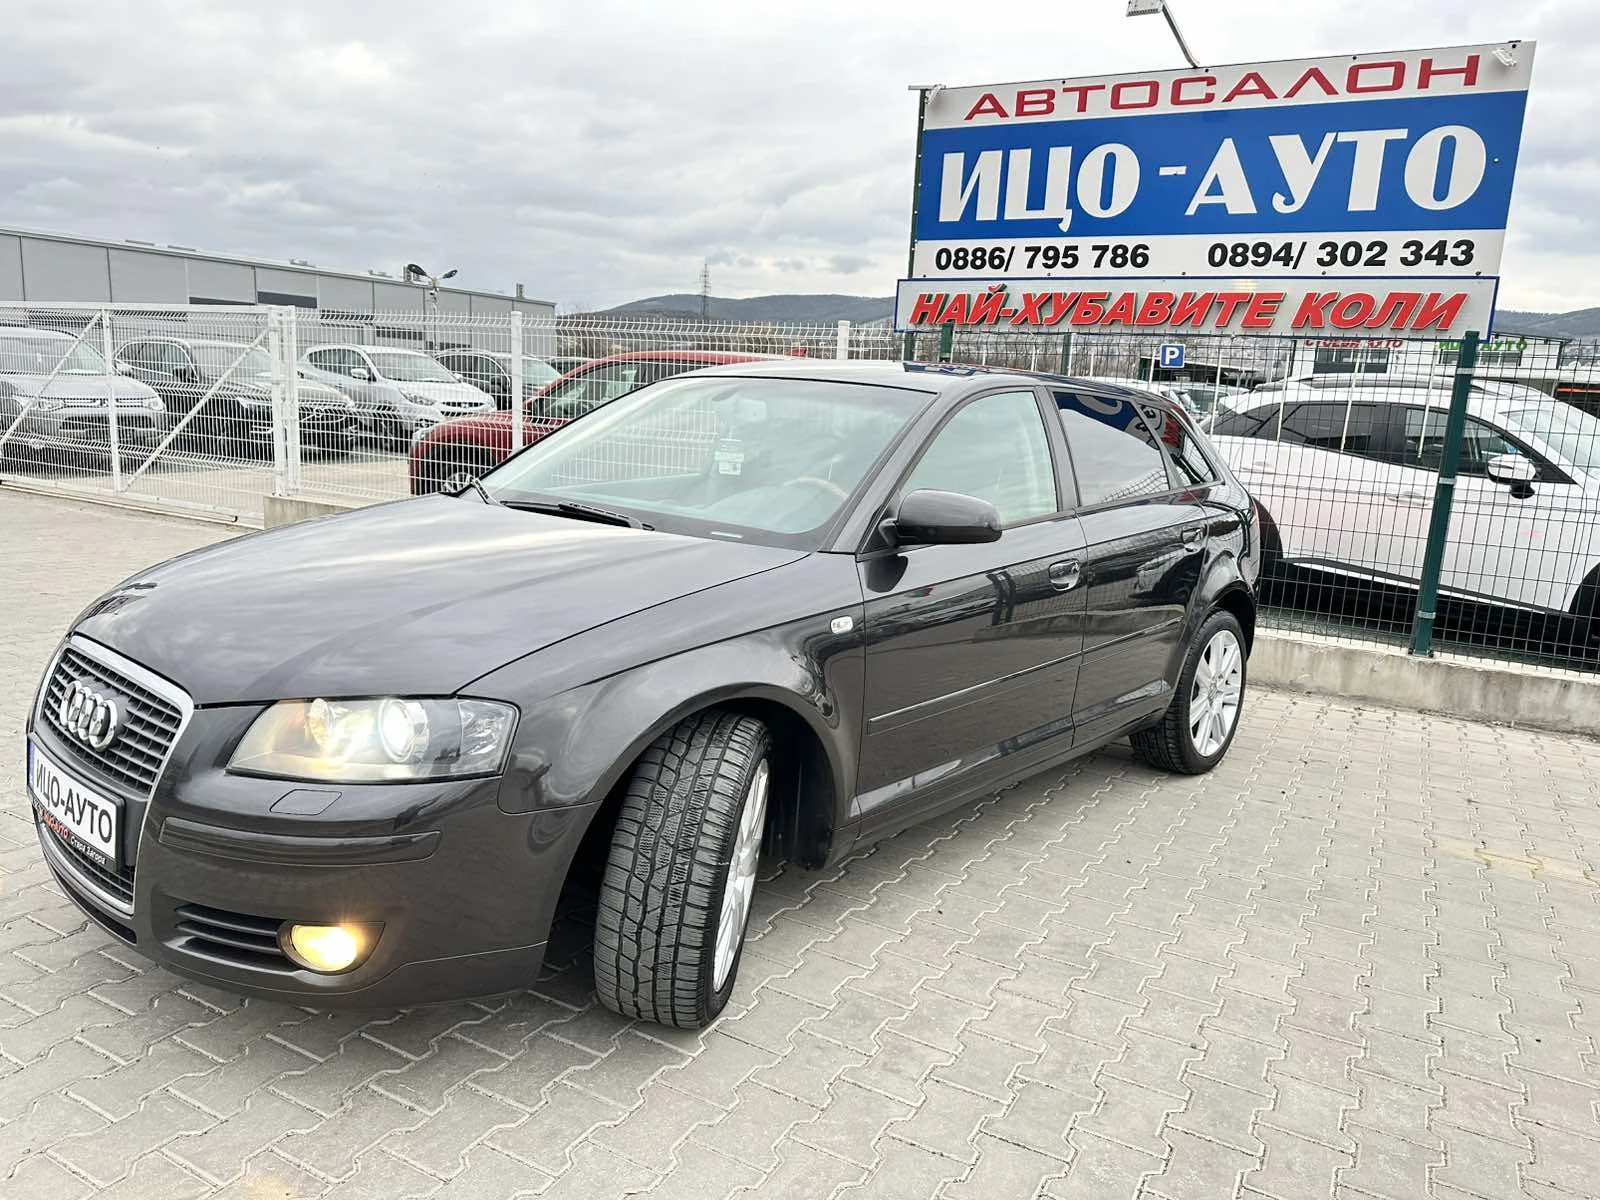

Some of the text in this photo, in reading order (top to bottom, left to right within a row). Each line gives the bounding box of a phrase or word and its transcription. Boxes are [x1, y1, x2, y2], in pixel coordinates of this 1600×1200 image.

[963, 54, 1481, 121] АВТОСАЛОН
[935, 243, 1151, 272] 0886/ 795 786
[1207, 239, 1475, 269] 0894/ 302 343
[908, 284, 1469, 330] НАЙ-ХУБАВИТЕ КОЛИ
[1165, 346, 1180, 365] P
[36, 759, 113, 844] ИЦО-АУТО
